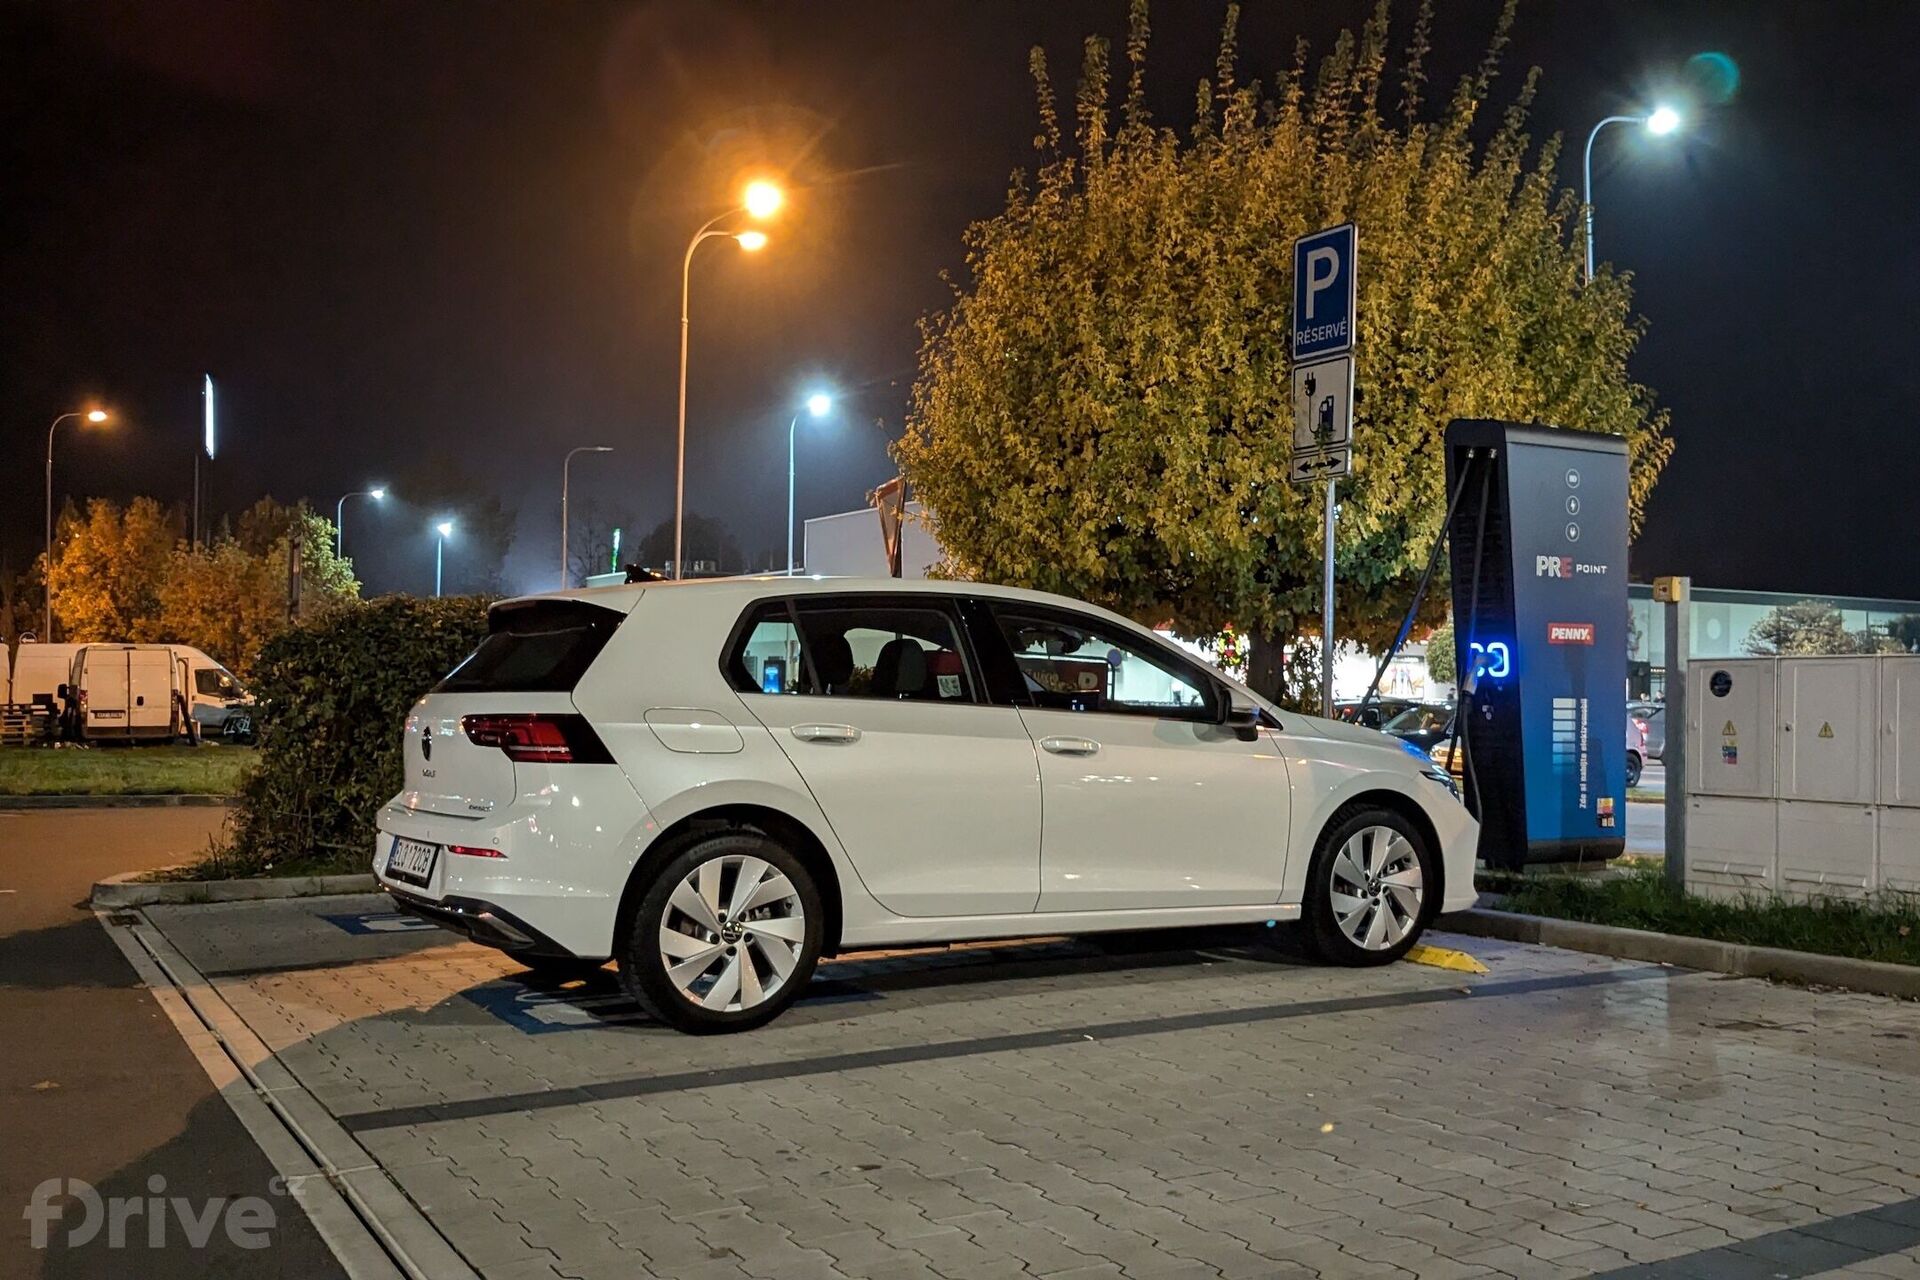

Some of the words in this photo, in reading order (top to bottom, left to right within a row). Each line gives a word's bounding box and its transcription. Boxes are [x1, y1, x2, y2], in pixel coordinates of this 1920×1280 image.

[1305, 246, 1340, 319] P
[1296, 317, 1348, 346] RÉSERVÉ
[1536, 555, 1573, 578] PRE
[1576, 563, 1608, 575] POINT
